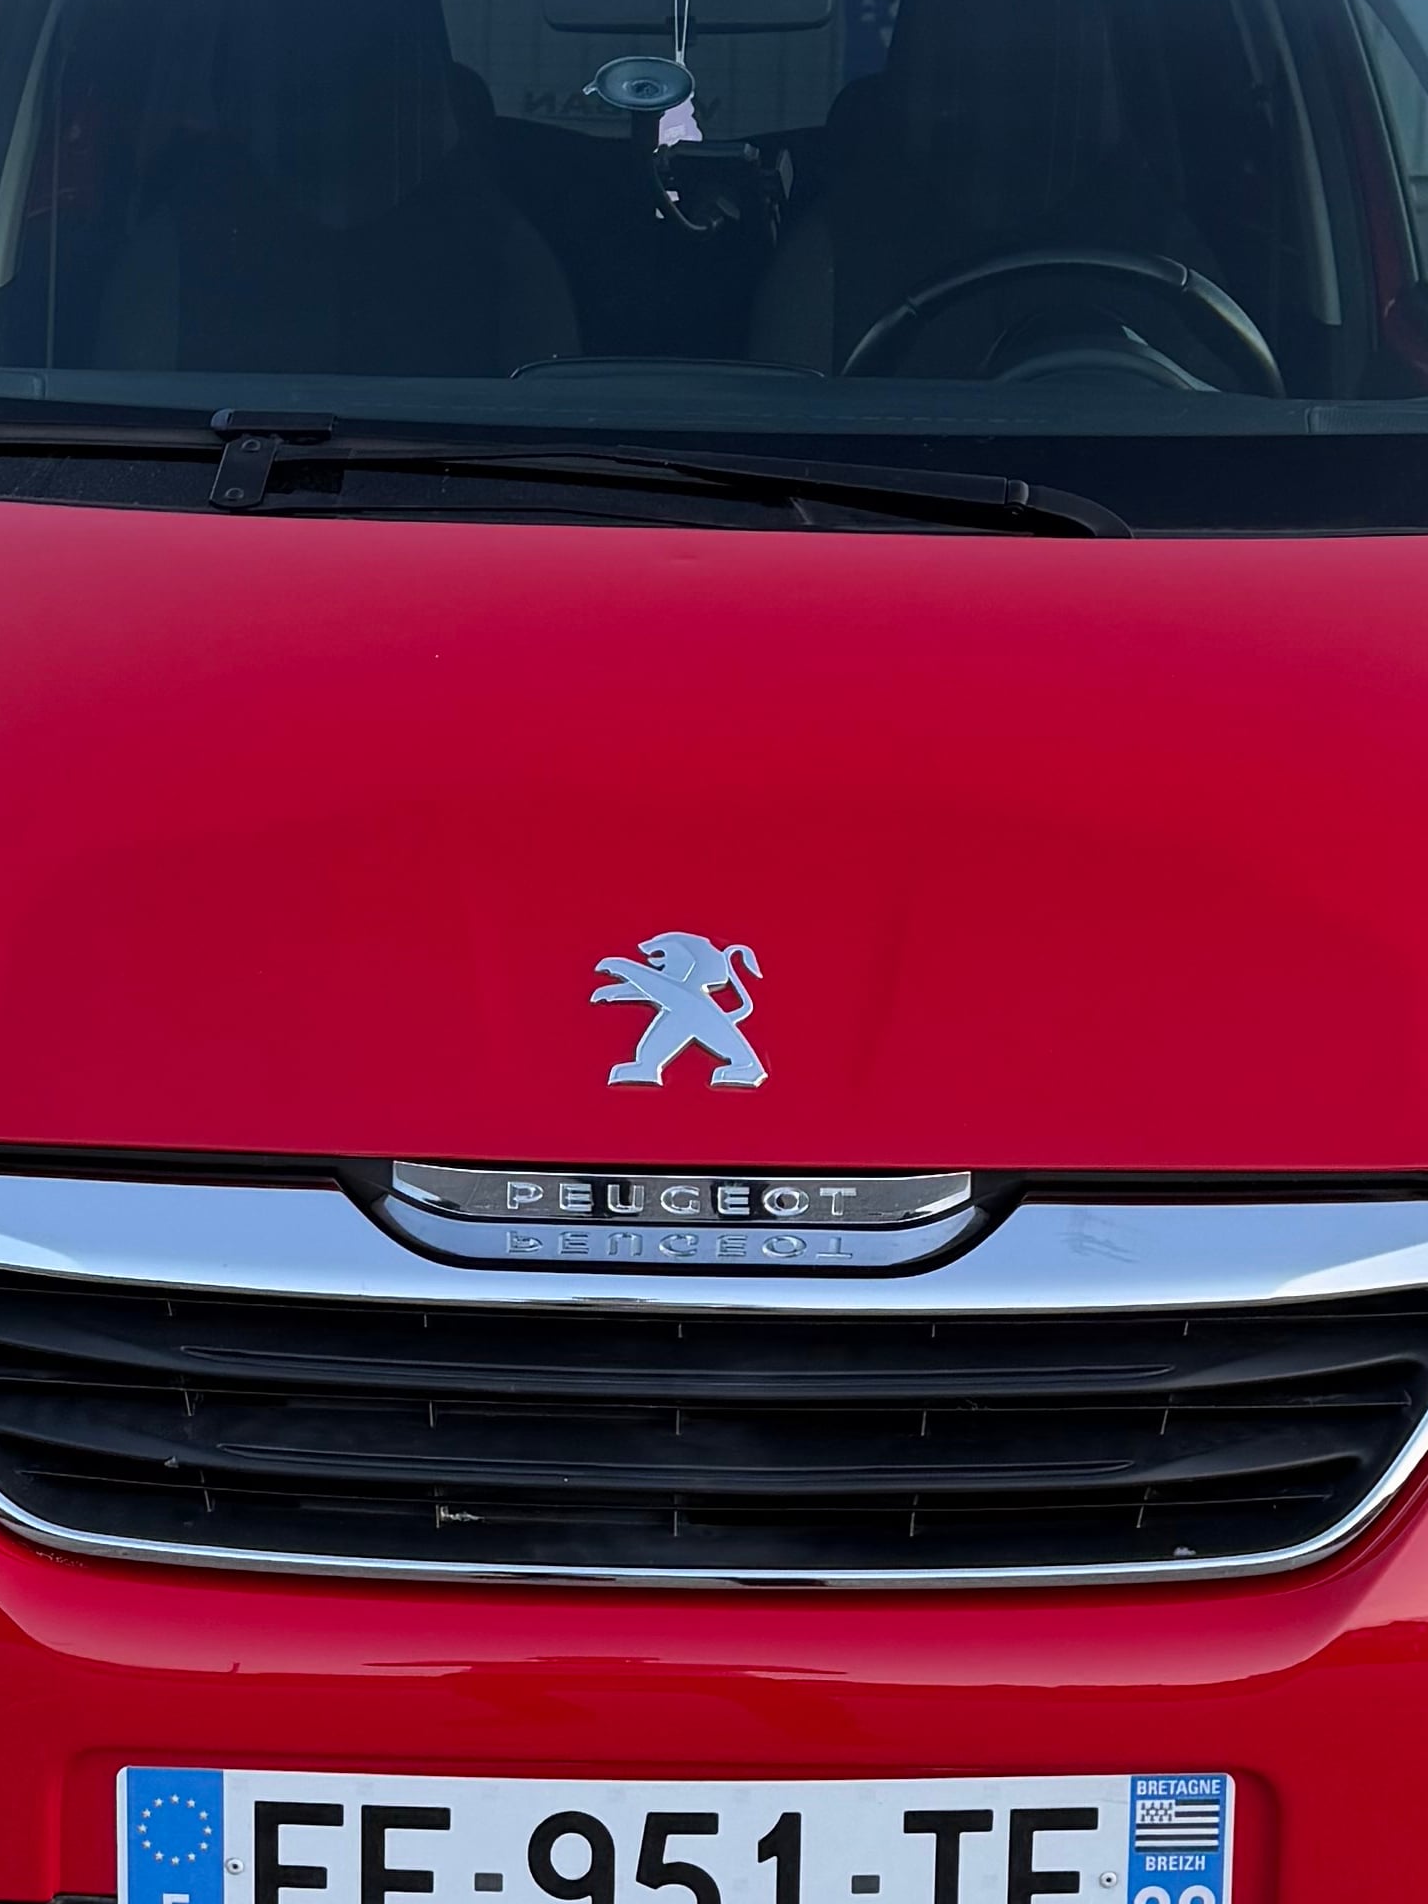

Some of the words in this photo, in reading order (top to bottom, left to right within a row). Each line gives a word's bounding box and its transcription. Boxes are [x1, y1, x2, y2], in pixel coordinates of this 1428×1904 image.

[506, 1180, 858, 1216] PEUGEOT
[1135, 1779, 1221, 1796] BRETAGNE
[1144, 1855, 1206, 1871] BREIZH
